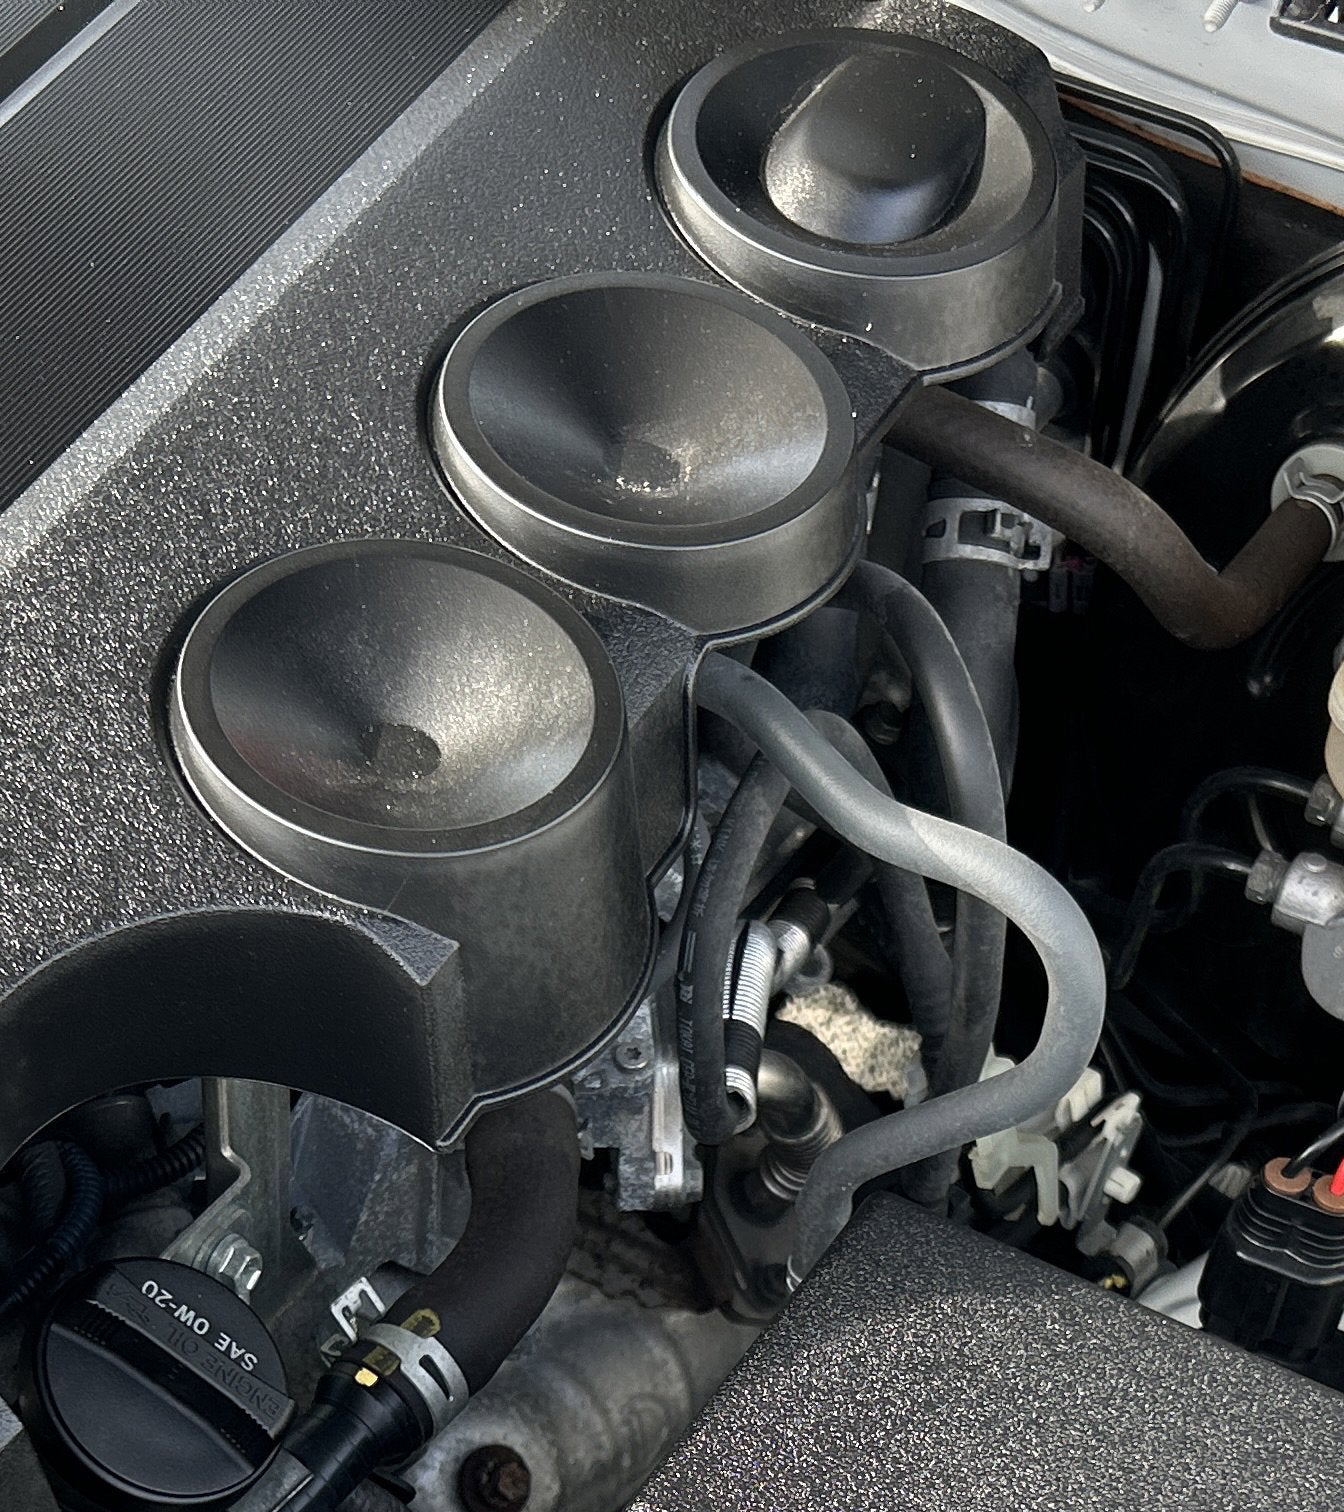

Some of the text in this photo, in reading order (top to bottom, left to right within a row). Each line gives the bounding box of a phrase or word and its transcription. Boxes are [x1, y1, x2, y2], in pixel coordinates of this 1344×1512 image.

[136, 1277, 261, 1372] SAE 0W-20
[159, 1321, 287, 1419] ENGINE OIL
